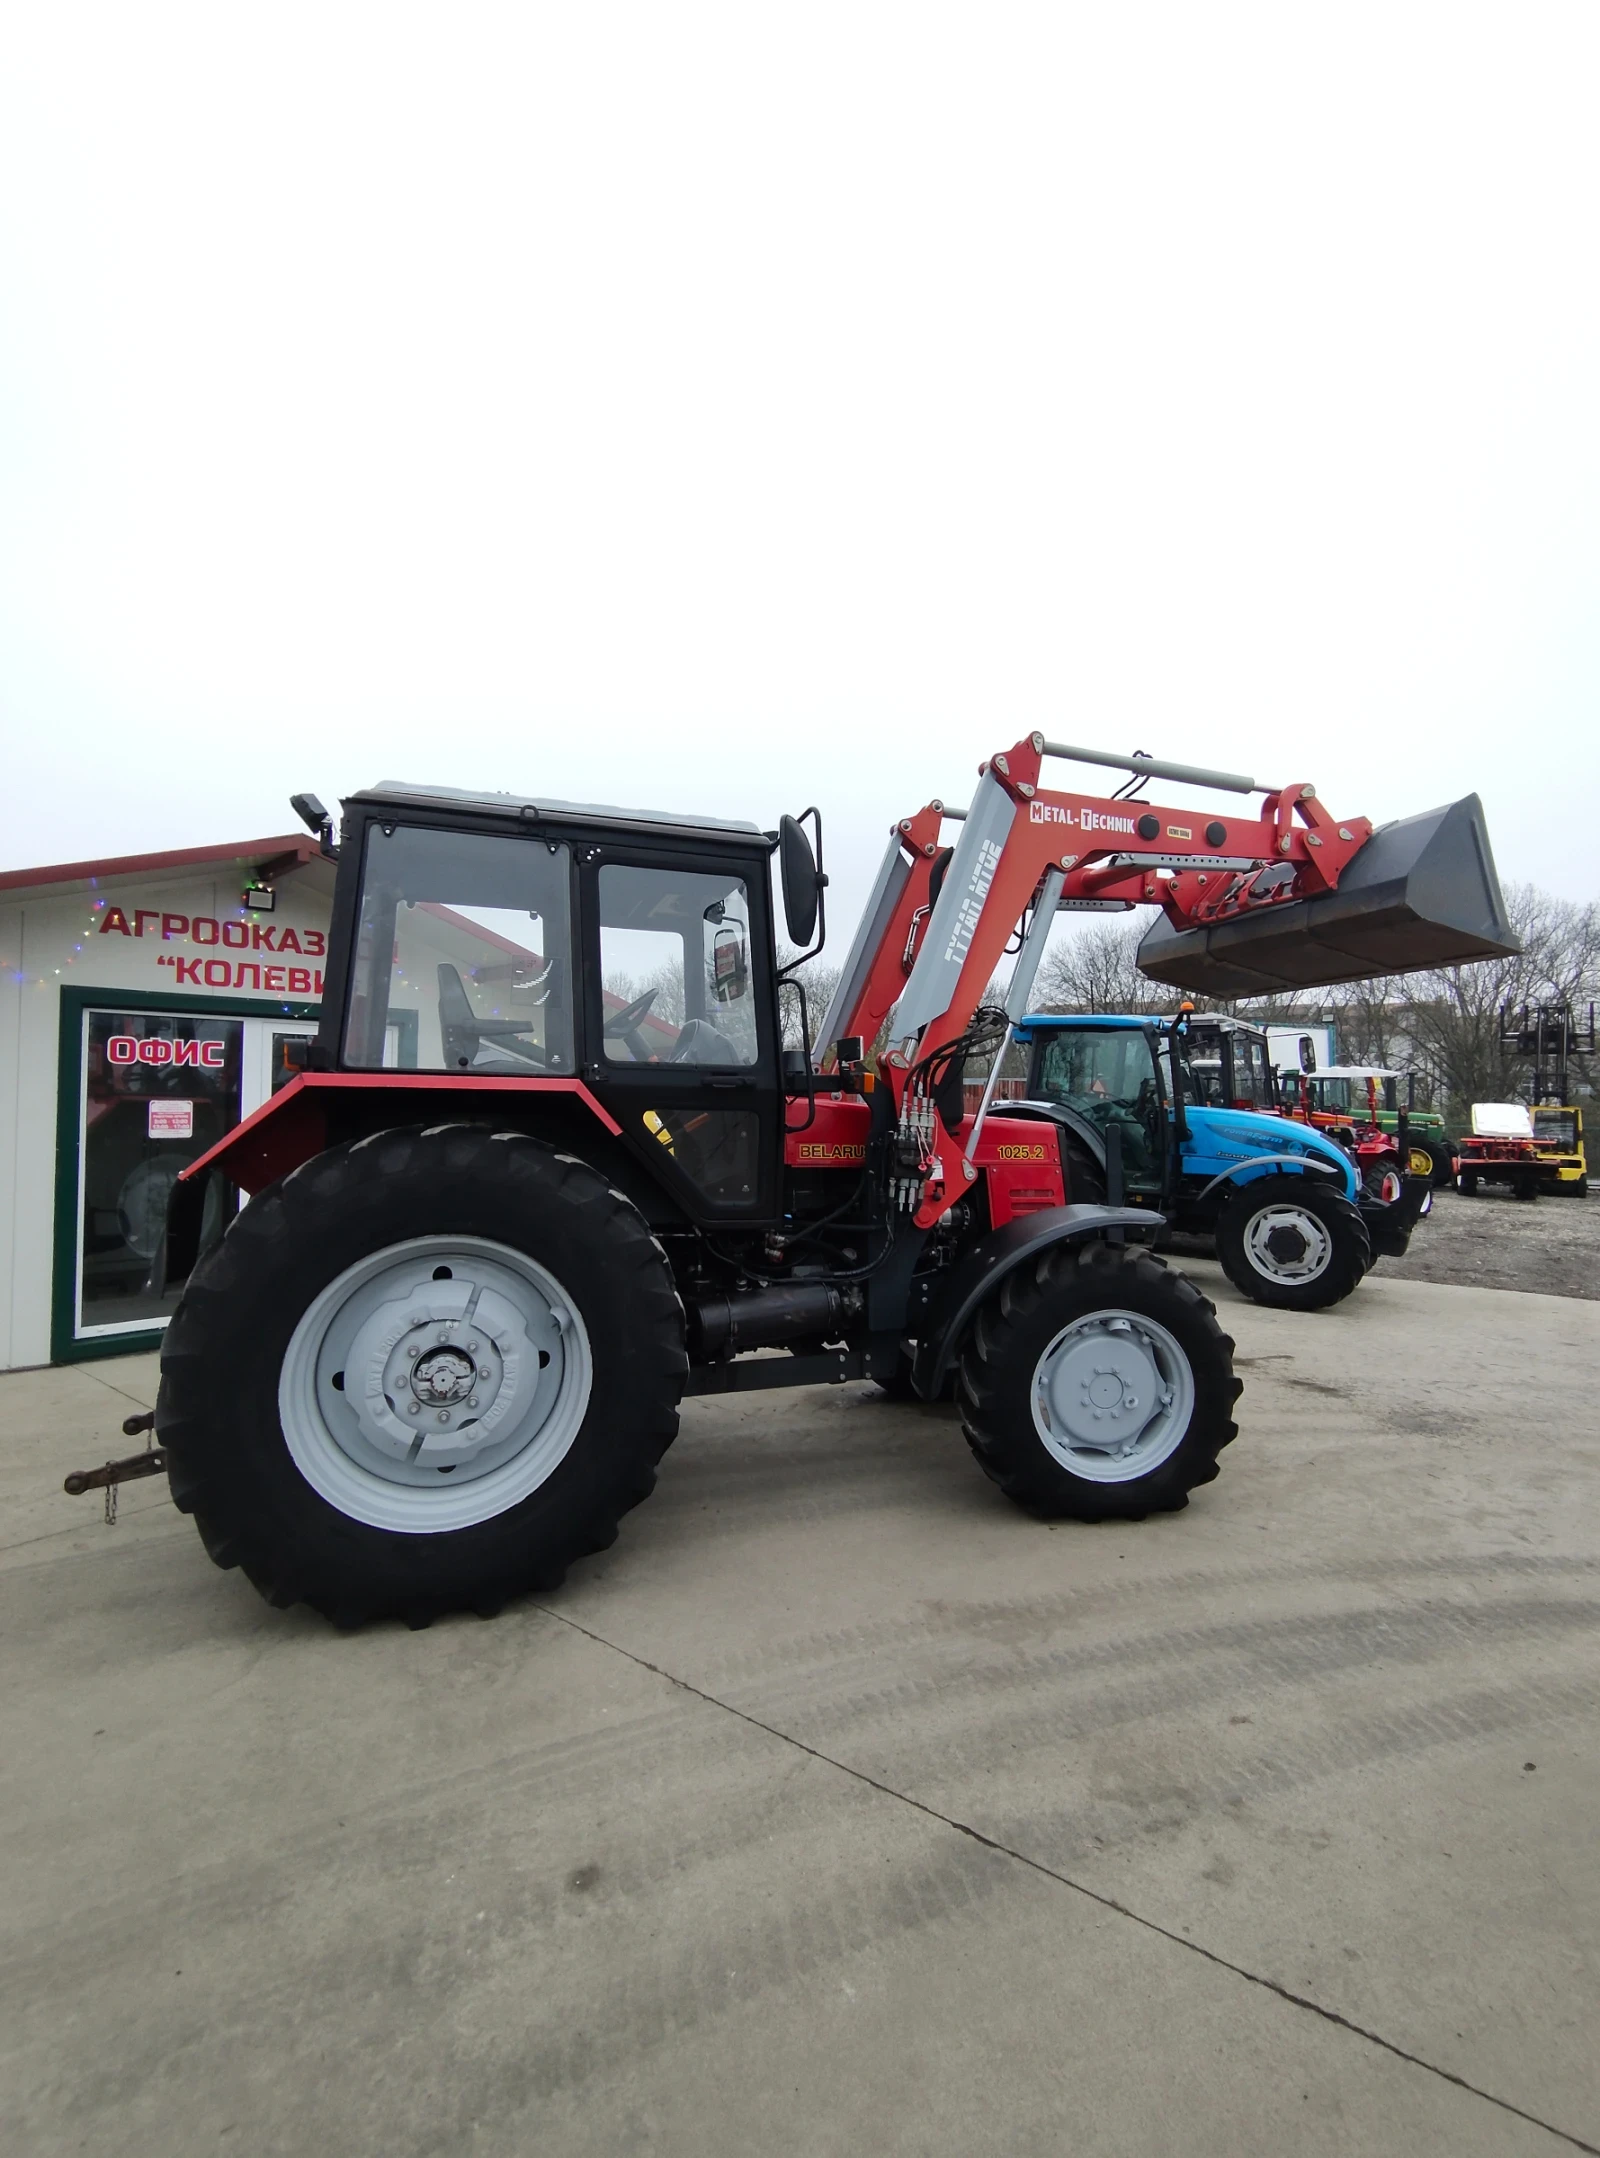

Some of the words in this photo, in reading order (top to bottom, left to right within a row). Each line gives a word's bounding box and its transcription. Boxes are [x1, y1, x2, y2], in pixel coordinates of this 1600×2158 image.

[107, 1035, 225, 1067] ОФИС
[800, 1144, 866, 1159] BELARU
[997, 1144, 1044, 1160] 1025.2
